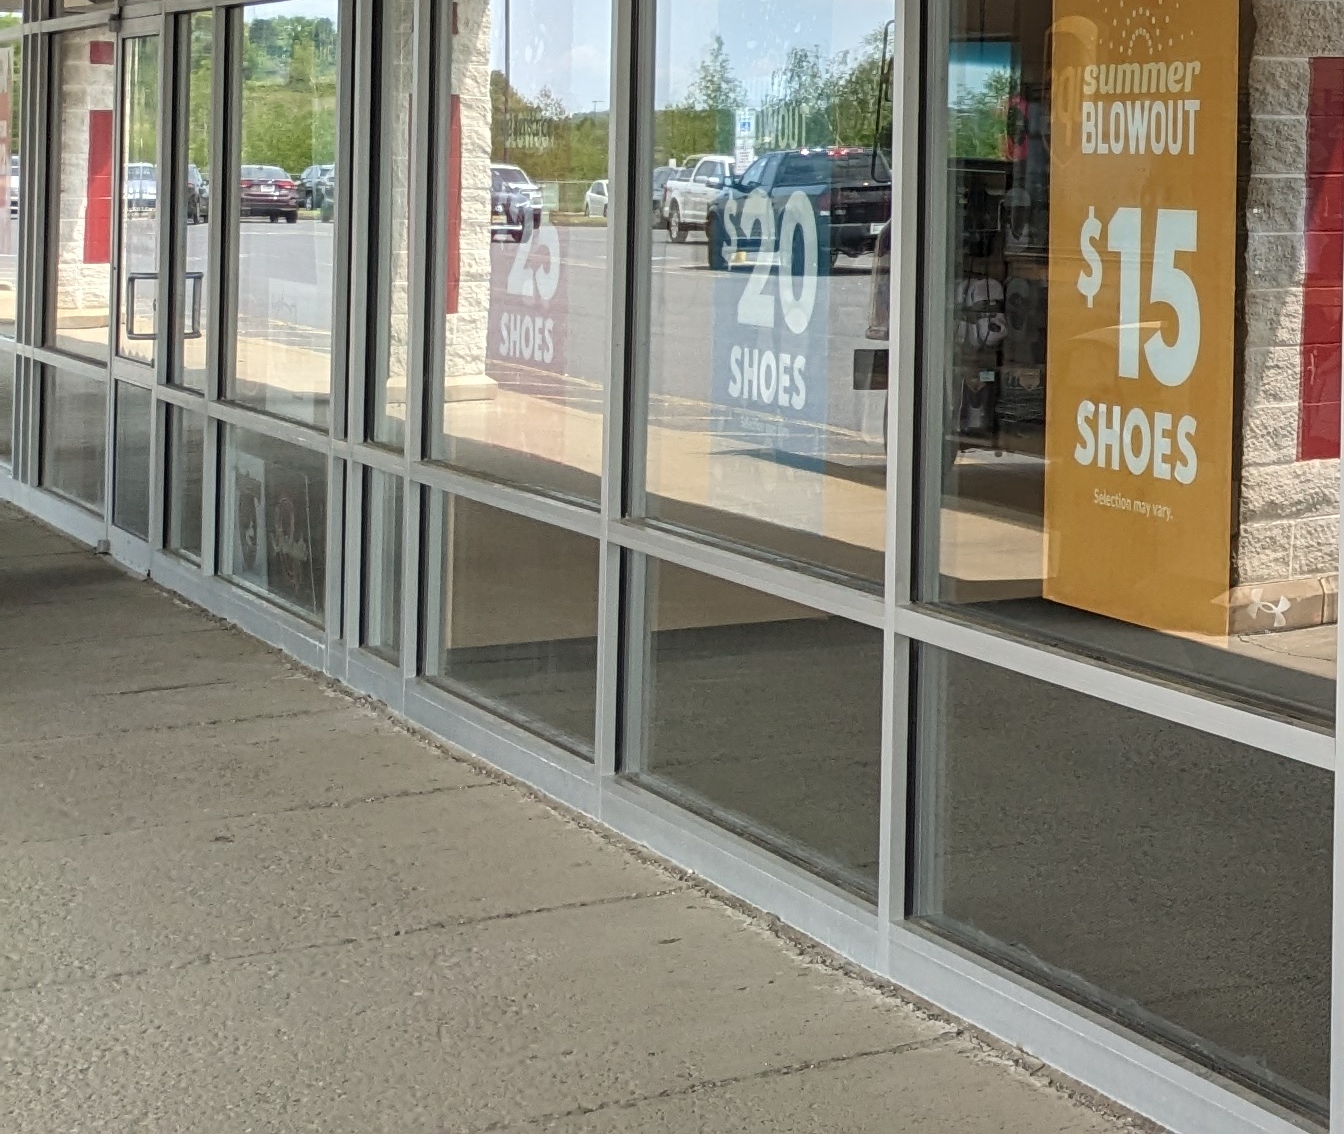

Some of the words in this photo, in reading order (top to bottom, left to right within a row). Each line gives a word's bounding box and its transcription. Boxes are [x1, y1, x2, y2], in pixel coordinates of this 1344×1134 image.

[1083, 60, 1200, 95] summer
[1081, 99, 1200, 156] BLOWOUT
[722, 186, 818, 334] $20
[1076, 205, 1200, 387] $15
[500, 314, 554, 364] SHOES
[728, 344, 806, 410] SHOES
[1074, 399, 1198, 485] SHOES
[1094, 488, 1132, 511] Selection
[1133, 500, 1152, 518] may
[1152, 503, 1174, 521] vary.
